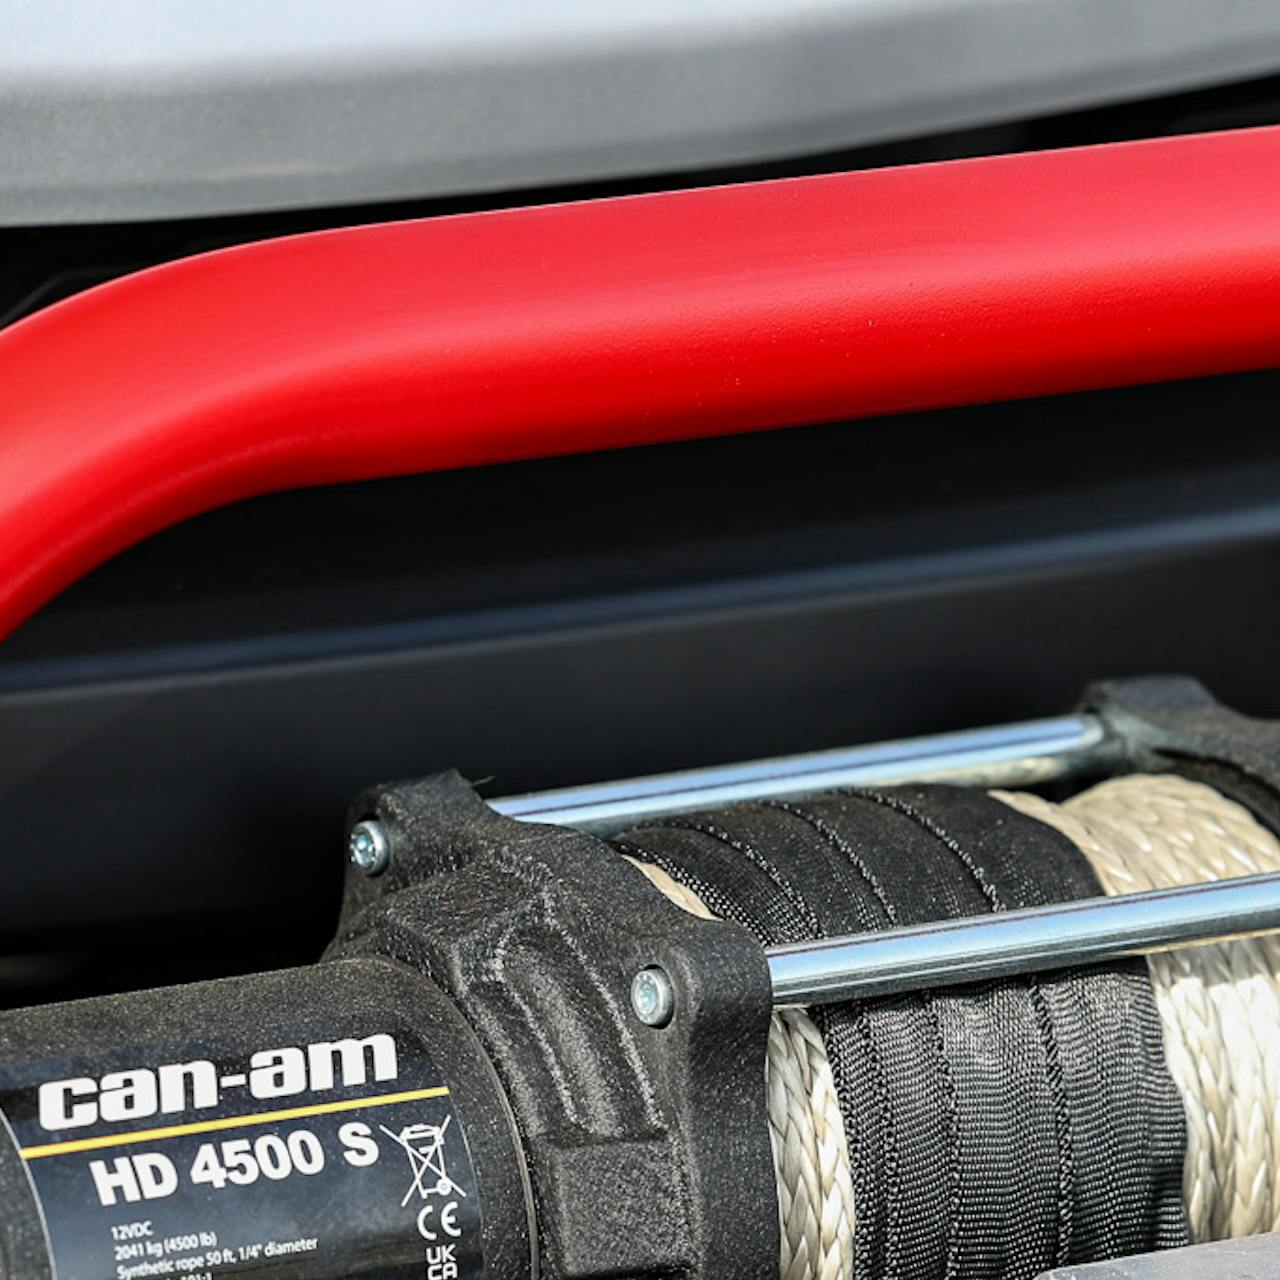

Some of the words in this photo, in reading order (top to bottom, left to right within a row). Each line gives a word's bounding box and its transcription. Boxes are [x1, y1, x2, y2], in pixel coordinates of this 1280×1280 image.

[39, 1034, 398, 1131] can-am
[89, 1152, 178, 1206] HD
[190, 1130, 325, 1188] 4500
[338, 1122, 379, 1167] S
[111, 1221, 153, 1240] 12VDC
[417, 1202, 462, 1240] CE
[114, 1242, 144, 1260] 2041
[145, 1241, 163, 1257] kg
[164, 1234, 198, 1254] (4500
[199, 1231, 217, 1247] lb)
[175, 1256, 204, 1271] rope
[205, 1251, 222, 1267] 50
[264, 1239, 318, 1257] diameter
[426, 1244, 456, 1264] UK
